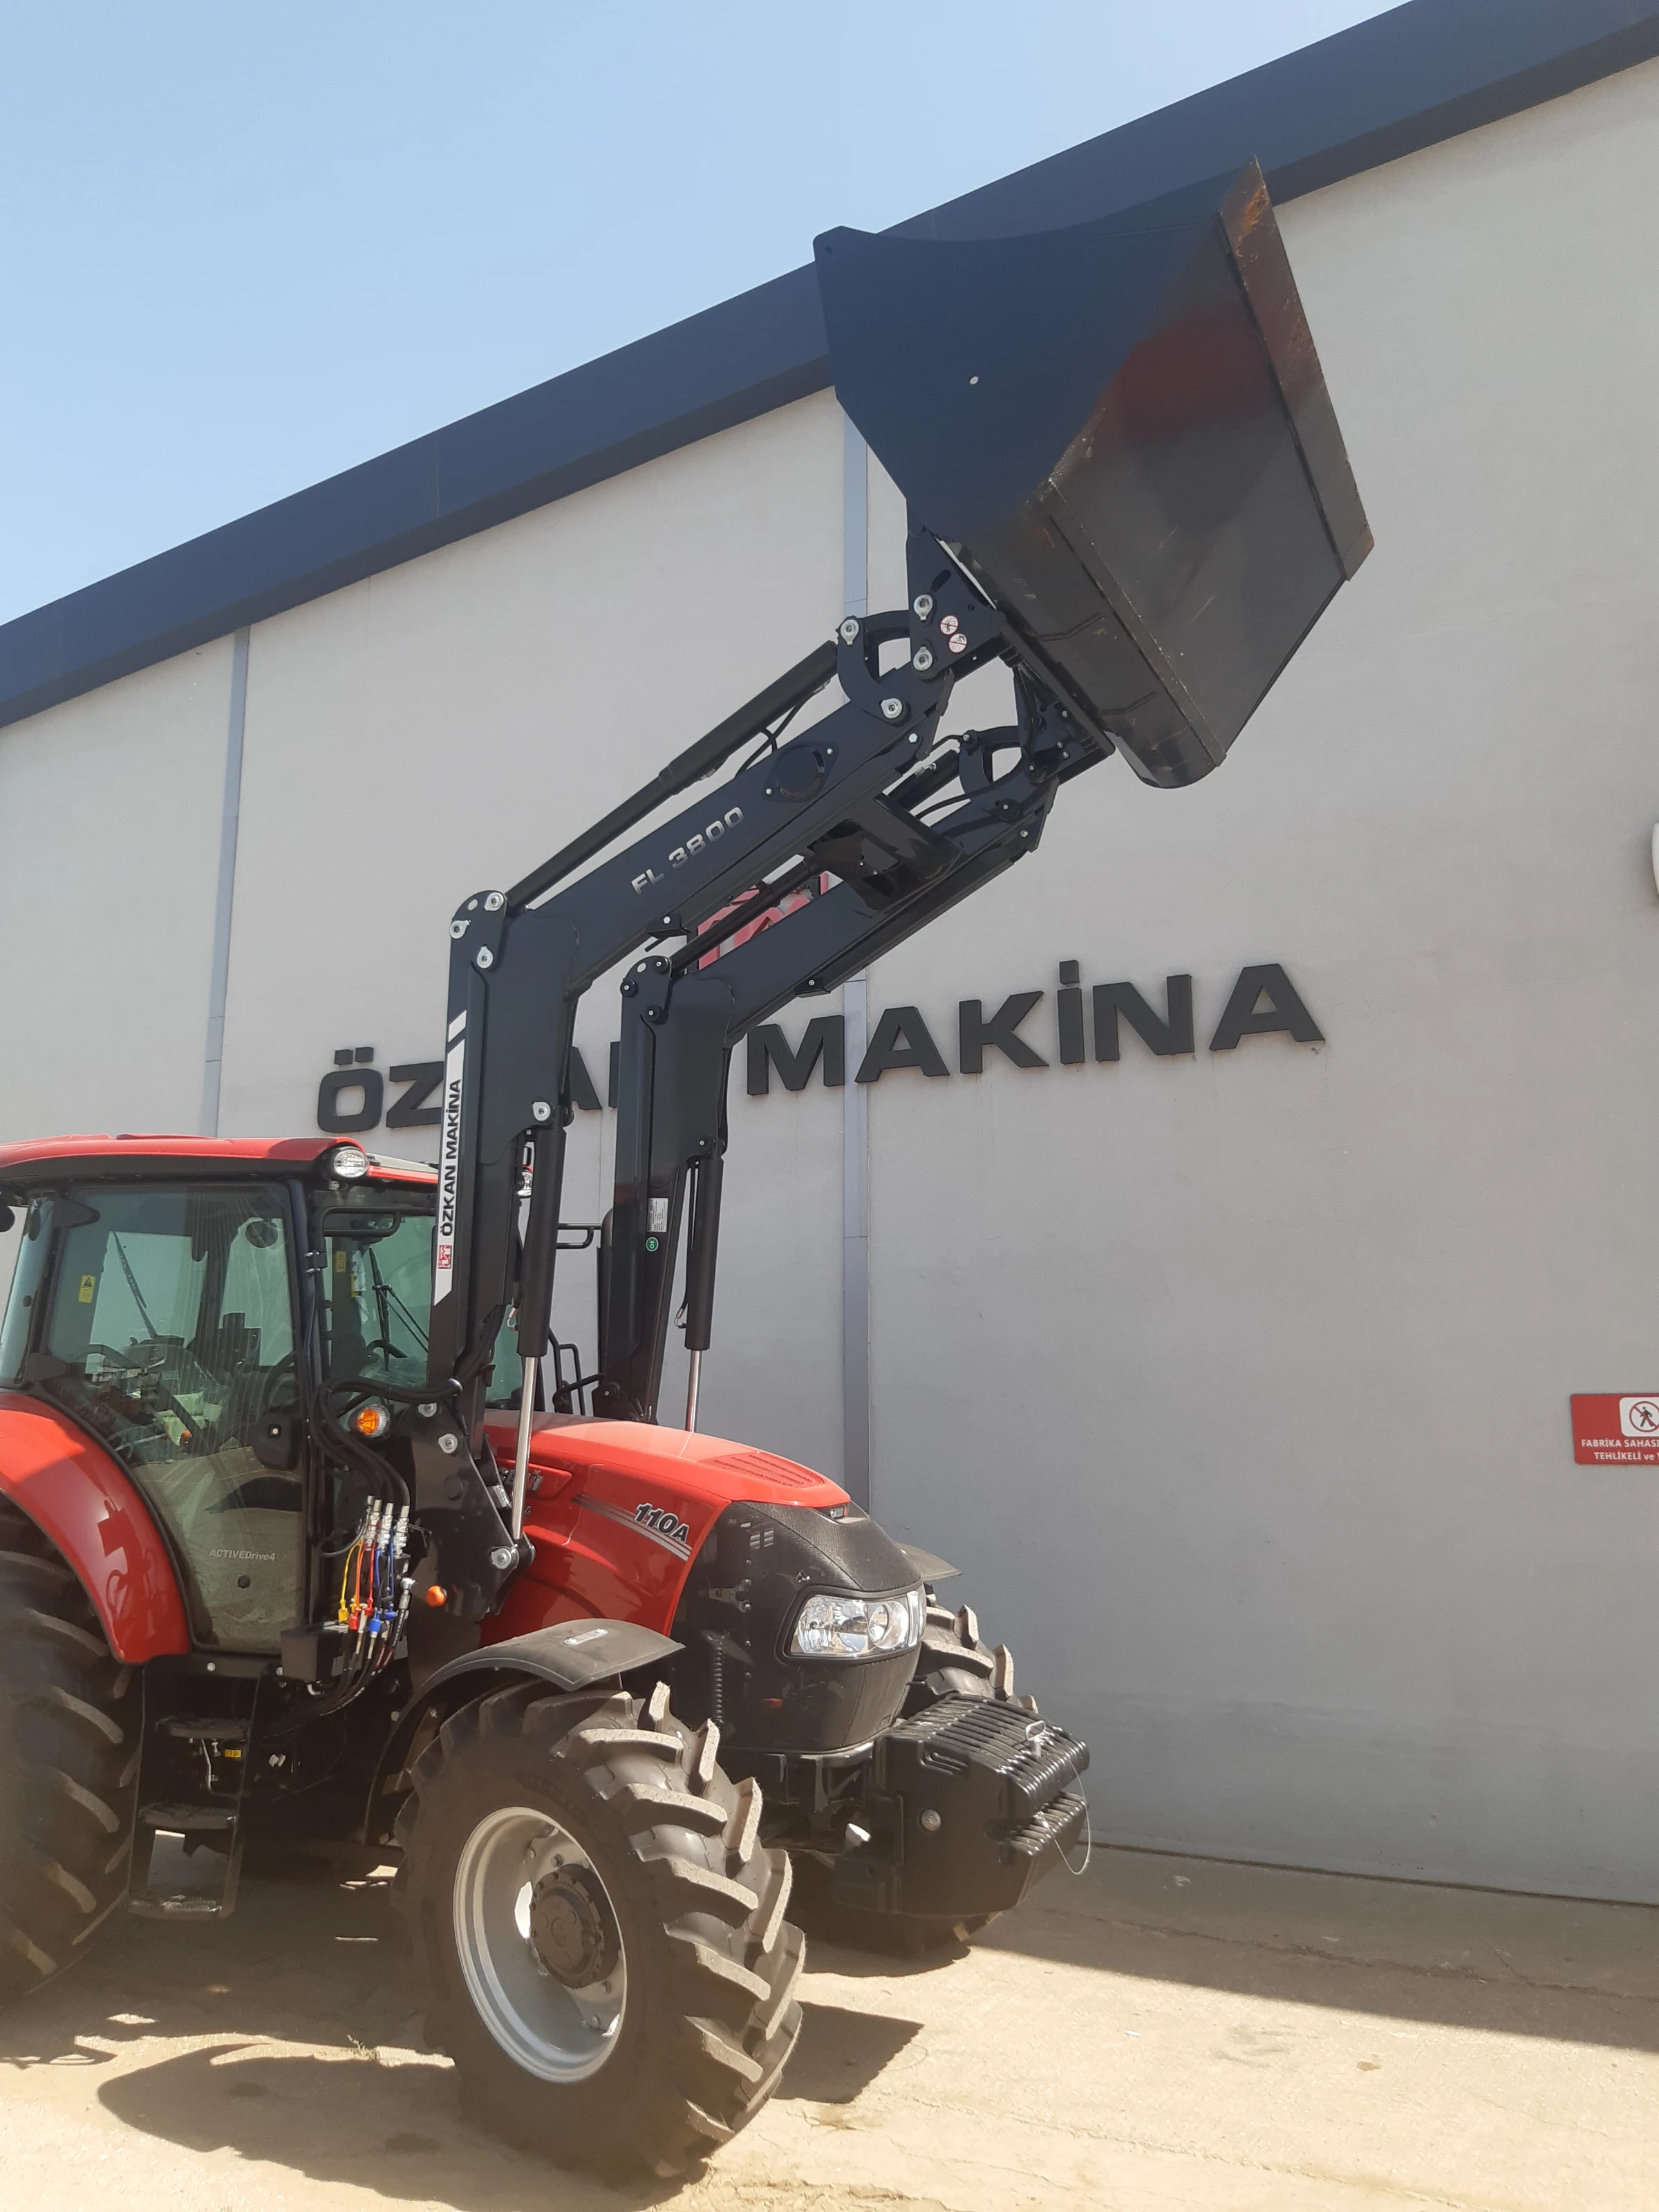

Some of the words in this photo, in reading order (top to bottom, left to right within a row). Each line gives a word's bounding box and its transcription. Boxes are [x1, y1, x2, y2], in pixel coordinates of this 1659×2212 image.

[631, 868, 666, 895] FL
[668, 807, 744, 870] 3800
[747, 959, 1325, 1096] MAKİNA
[445, 1078, 462, 1159] MAKİNA
[440, 1165, 457, 1237] ÖZKAN
[650, 1239, 655, 1249] OK
[1581, 1438, 1622, 1447] FABRİKA
[1593, 1450, 1642, 1461] TEHLİKELİ
[634, 1502, 690, 1544] 110A
[209, 1548, 276, 1562] ACTIVEDrive4
